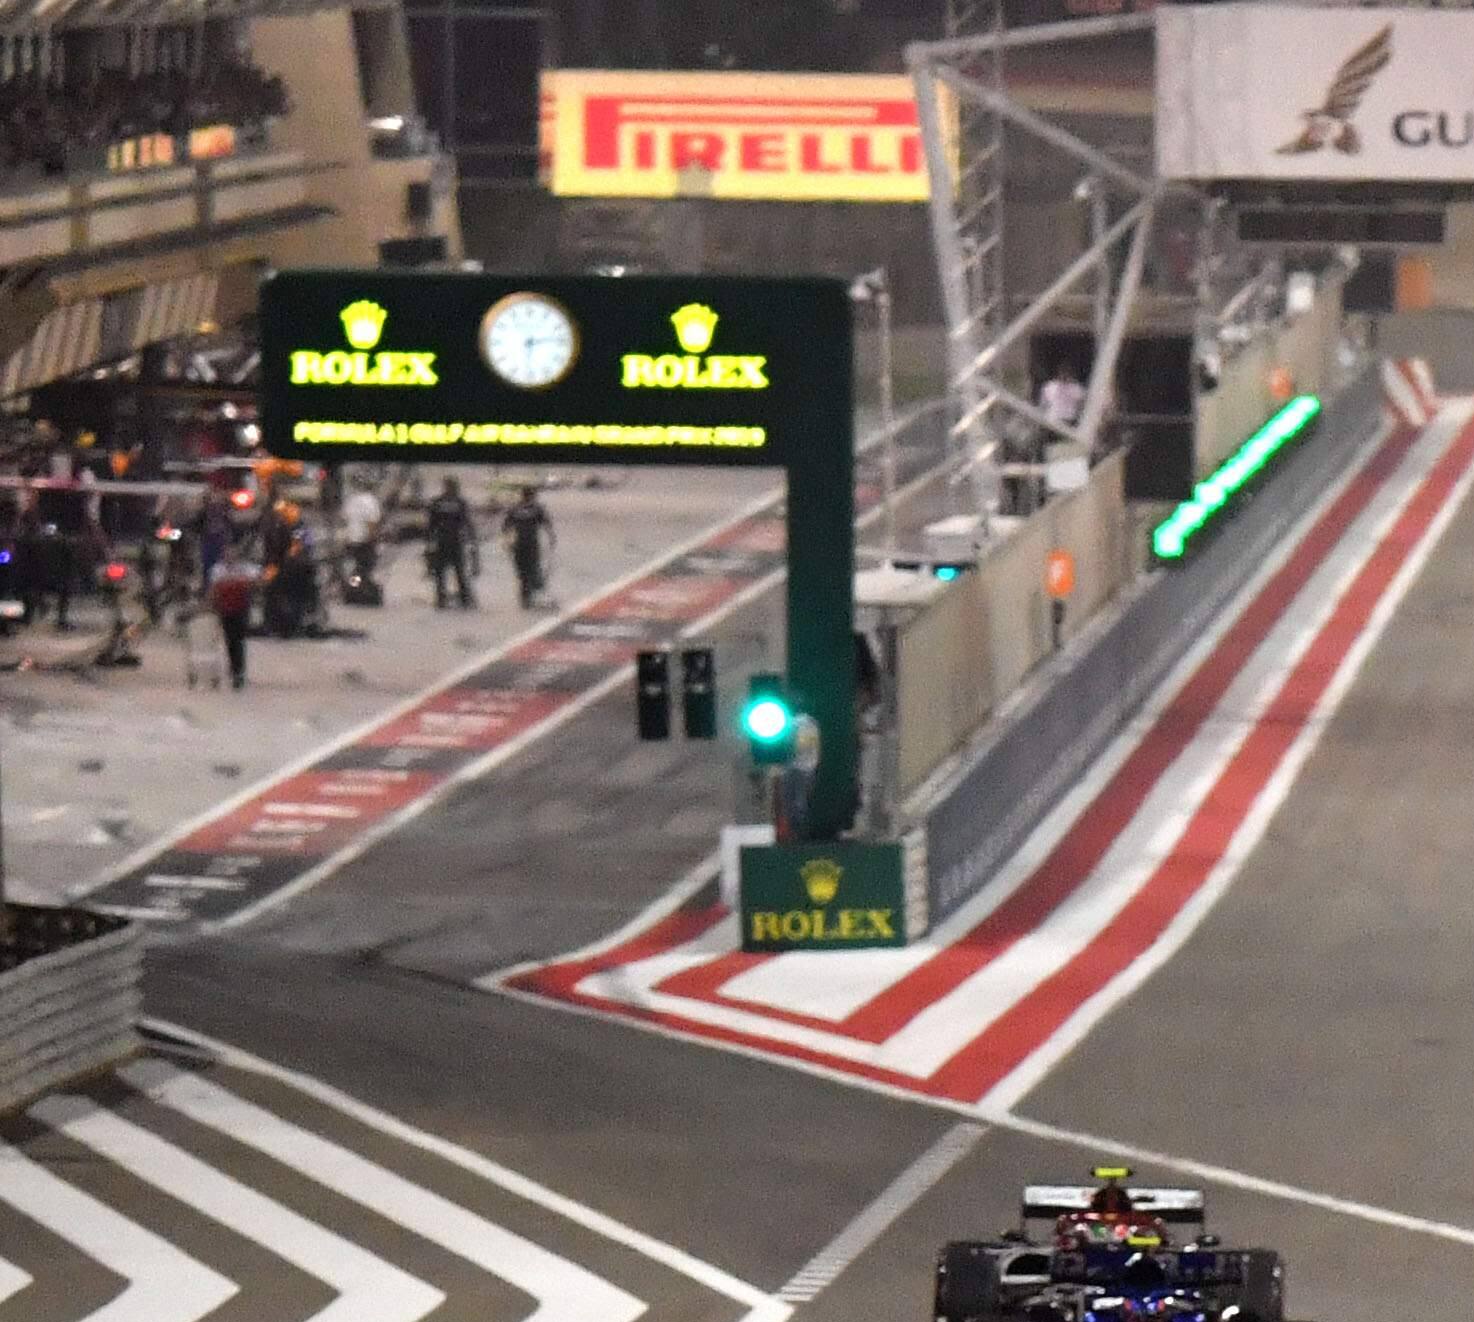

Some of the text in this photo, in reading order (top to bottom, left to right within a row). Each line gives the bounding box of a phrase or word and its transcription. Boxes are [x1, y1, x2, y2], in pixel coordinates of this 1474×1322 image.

[583, 96, 926, 173] PIRELLI
[290, 350, 439, 386] ROLEX
[621, 353, 769, 389] ROLEX
[752, 907, 894, 941] ROLEX
